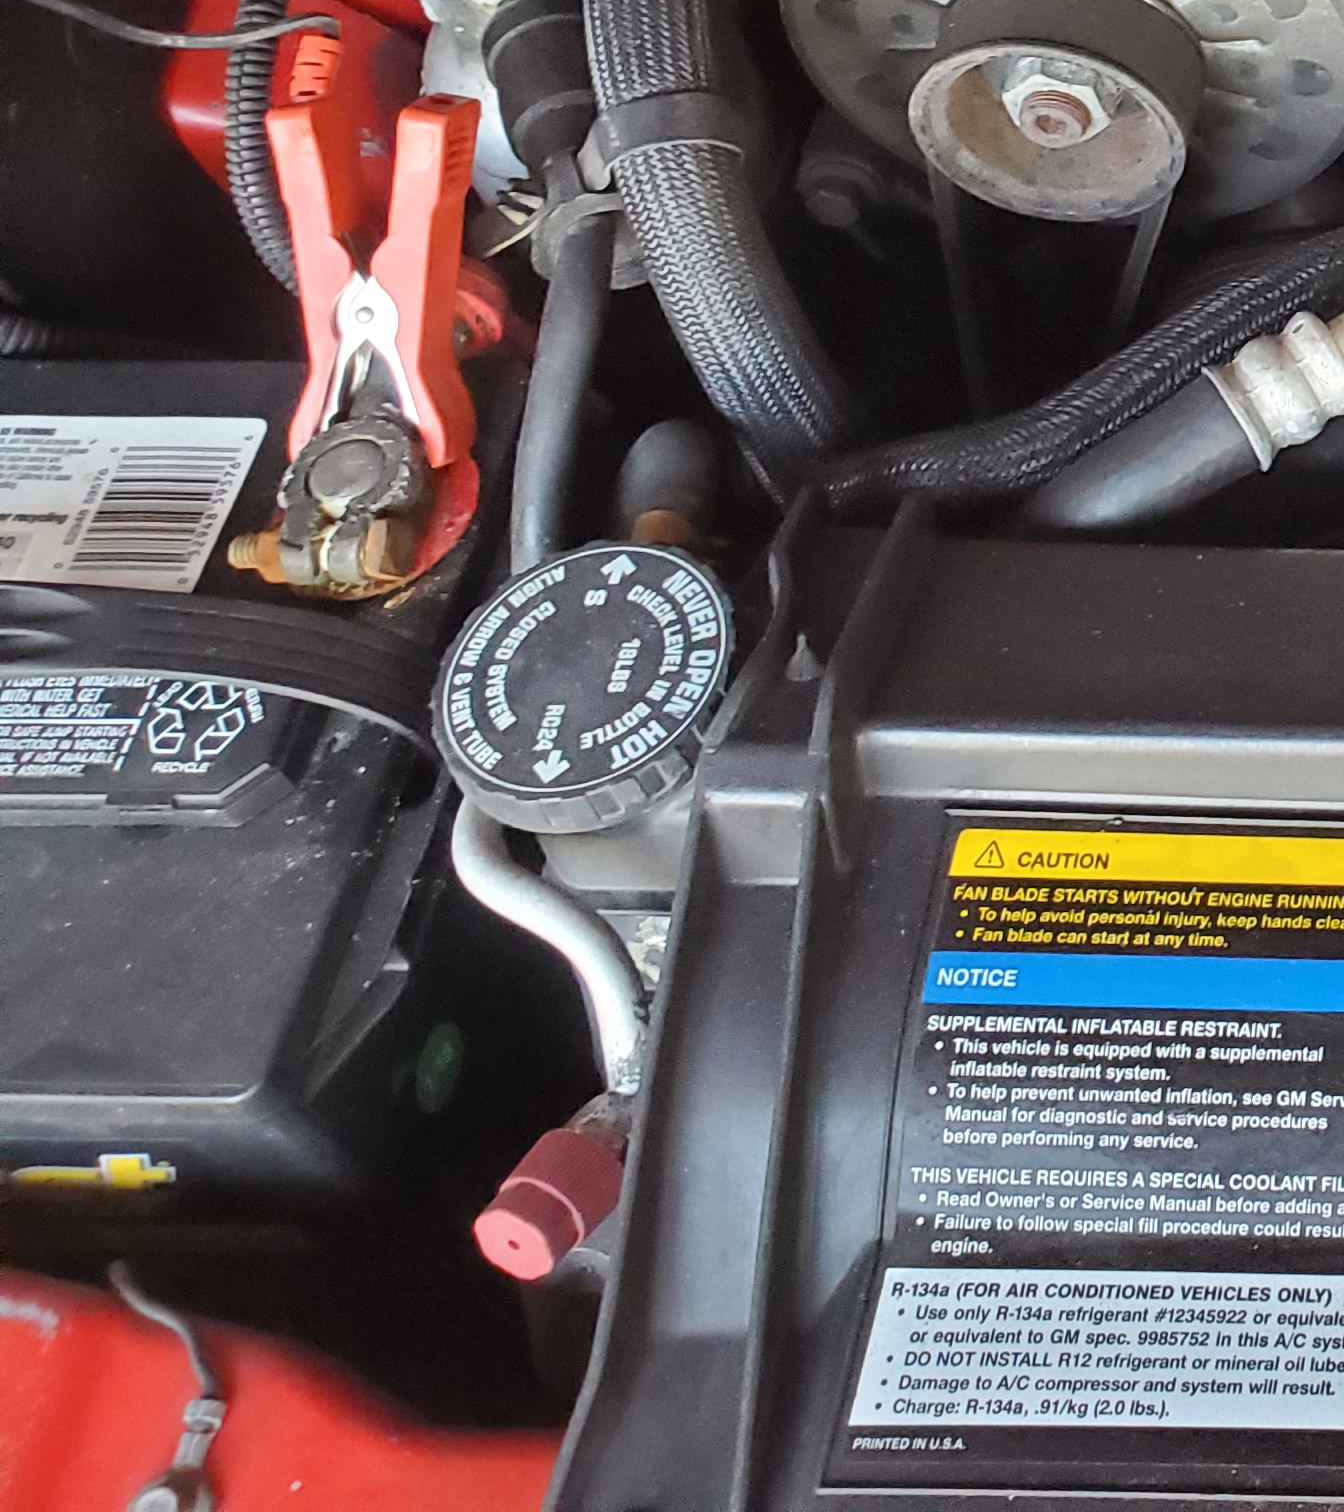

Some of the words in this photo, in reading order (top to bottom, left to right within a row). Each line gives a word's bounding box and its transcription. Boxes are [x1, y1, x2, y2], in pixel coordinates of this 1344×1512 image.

[508, 565, 566, 609] ALIGN
[627, 584, 679, 626] CHECK
[662, 569, 718, 643] NEVER
[460, 606, 510, 668] ARROW
[494, 600, 556, 660] CLOSED
[659, 623, 684, 676] LEVEL
[646, 679, 672, 703] IN
[662, 648, 717, 720] OPEN
[451, 687, 477, 732] VENT
[580, 702, 652, 750] BOTTLE
[460, 731, 503, 771] TUBE
[609, 720, 668, 770] HOT
[1017, 851, 1110, 870] CAUTION
[953, 883, 988, 901] FAN
[990, 887, 1050, 902] BLADE
[1052, 888, 1119, 904] STARTS
[1123, 887, 1205, 906] WITHOUT
[1207, 892, 1274, 908] ENGINE
[978, 906, 997, 922] To
[1000, 907, 1037, 925] help
[1039, 909, 1085, 924] avoid
[1087, 909, 1161, 927] personal
[1163, 911, 1212, 929] injury,
[1216, 912, 1257, 930] keep
[1261, 914, 1312, 929] hands
[972, 927, 1003, 942] Fan
[1007, 928, 1053, 943] blade
[1056, 932, 1087, 944] can
[1091, 931, 1130, 947] start
[1132, 932, 1150, 946] at
[1153, 935, 1185, 949] any
[1188, 932, 1228, 948] time.
[937, 968, 1018, 987] NOTICE
[926, 1015, 1068, 1034] SUPPLEMENTAL
[1071, 1018, 1178, 1036] INFLATABLE
[1180, 1020, 1282, 1039] RESTRAINT.
[952, 1037, 988, 1054] This
[992, 1039, 1051, 1056] vehicle
[1054, 1040, 1069, 1056] is
[1073, 1041, 1152, 1061] equipped
[1155, 1043, 1192, 1059] with
[1194, 1047, 1206, 1059] a
[1209, 1044, 1324, 1064] supplemental
[949, 1060, 1027, 1078] inflatable
[1031, 1063, 1102, 1080] restraint
[1105, 1064, 1171, 1083] system.
[911, 1167, 951, 1183] THIS
[956, 1168, 1032, 1185] VEHICLE
[1036, 1169, 1128, 1187] REQUIRES
[1132, 1172, 1145, 1188] A
[1149, 1172, 1225, 1190] SPECIAL
[1229, 1174, 1318, 1192] COOLANT
[891, 1282, 950, 1299] R-134a
[956, 1282, 1001, 1301] (FOR
[1005, 1283, 1039, 1298] AIR
[1044, 1283, 1175, 1300] CONDITIONED
[1181, 1285, 1271, 1302] VEHICLES
[1277, 1287, 1332, 1308] ONLY)
[904, 1351, 932, 1367] DO
[936, 1351, 977, 1367] NOT
[979, 1351, 1053, 1367] INSTALL
[1058, 1352, 1092, 1368] R12
[1096, 1353, 1187, 1372] refrigerant
[1192, 1358, 1211, 1370] or
[1214, 1355, 1280, 1371] mineral
[1284, 1356, 1306, 1372] oil
[892, 1398, 961, 1418] Charge:
[965, 1398, 1028, 1417] R-134a,
[1034, 1399, 1089, 1419] .91/kg
[1093, 1399, 1125, 1419] (2.0
[1129, 1399, 1169, 1420] lbs.).
[852, 1437, 910, 1450] PRINTED
[912, 1438, 928, 1450] IN
